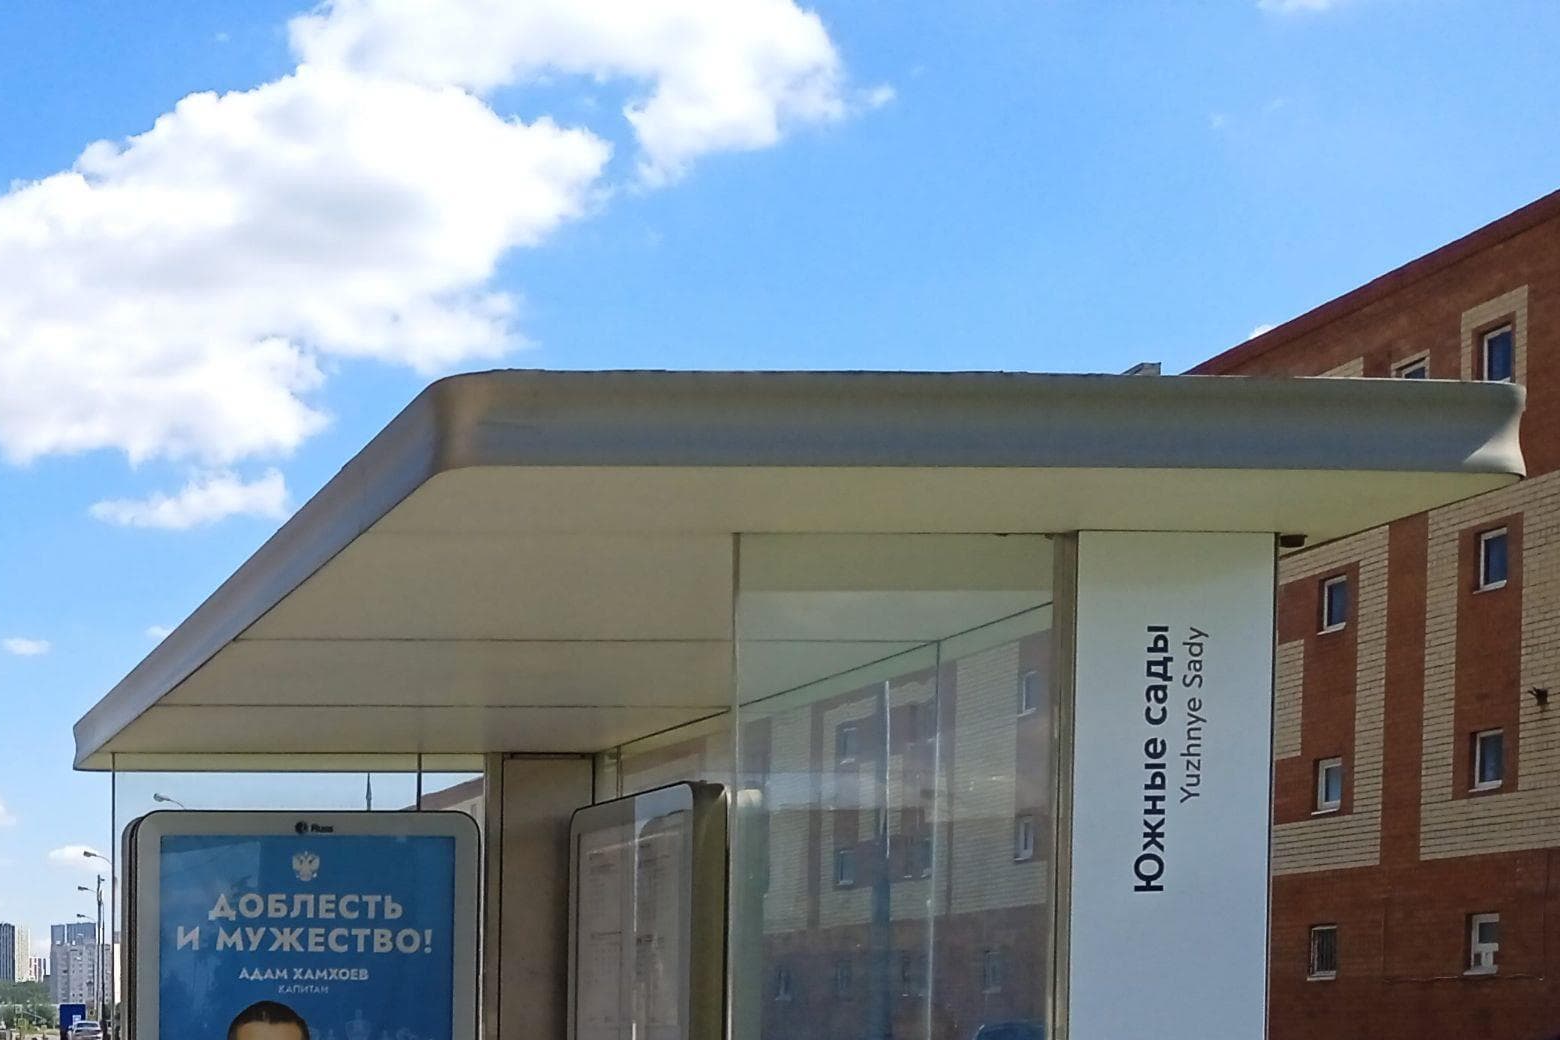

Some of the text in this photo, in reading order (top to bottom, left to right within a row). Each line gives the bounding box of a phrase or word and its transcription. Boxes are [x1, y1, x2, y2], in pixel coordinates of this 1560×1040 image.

[1179, 626, 1209, 804] Yuzhnye Sady
[1133, 625, 1174, 892] Южные сады
[207, 892, 404, 921] ДОБЛЕСТЬ
[176, 925, 433, 954] И МУЖЕСТВО!
[238, 966, 369, 981] АДАМ ХАМХОЕВ
[278, 984, 329, 995] КАПИТАН
